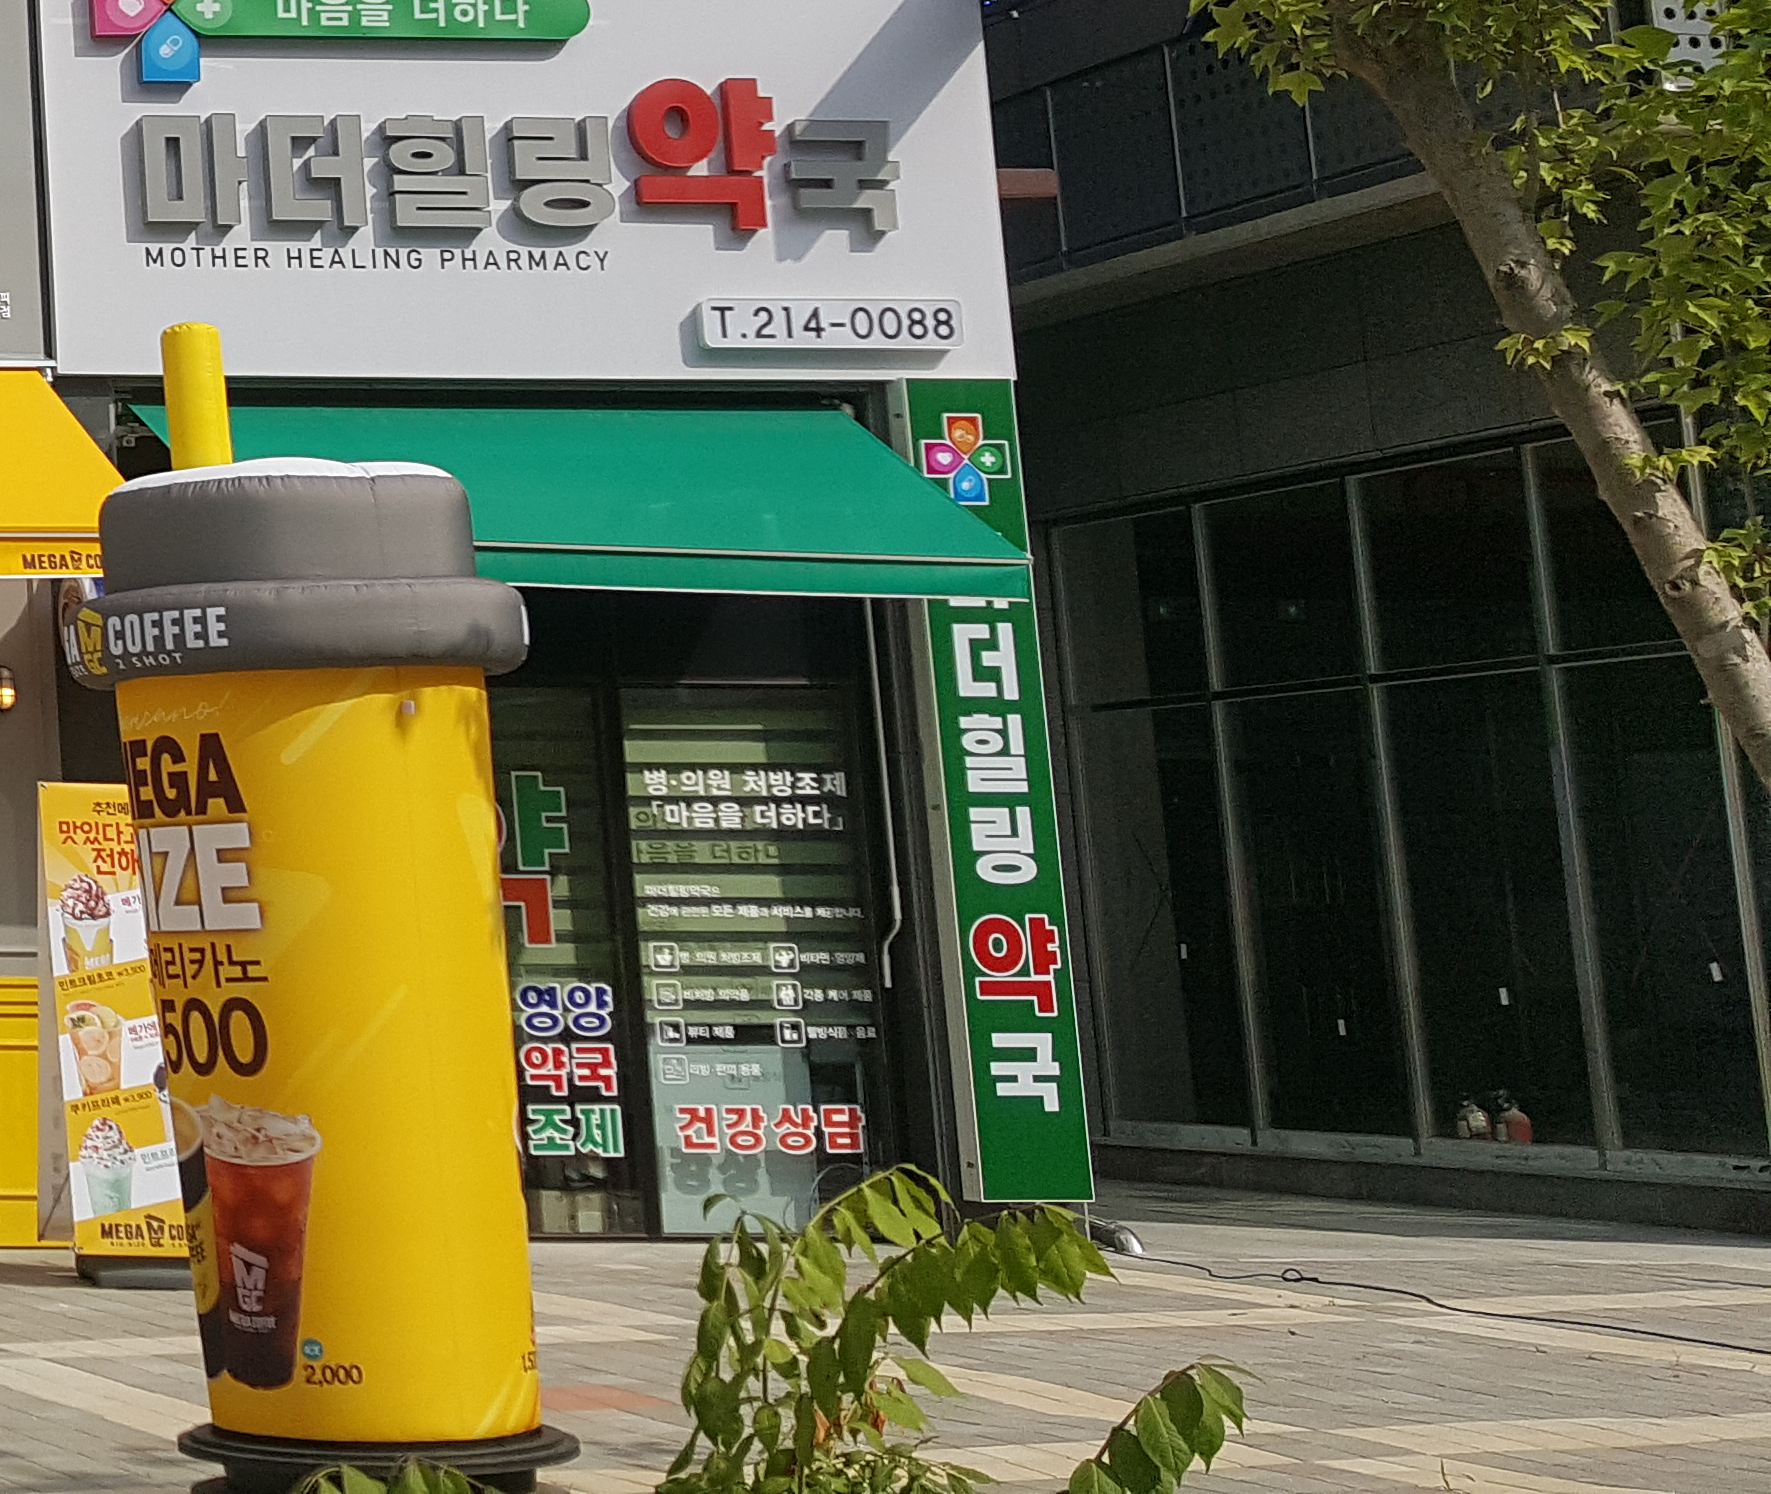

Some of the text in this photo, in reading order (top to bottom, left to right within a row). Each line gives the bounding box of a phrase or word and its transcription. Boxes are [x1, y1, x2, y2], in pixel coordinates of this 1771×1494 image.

[137, 77, 900, 235] 마더힐링약국
[144, 247, 611, 273] MOTHER HEALING PHARMACY
[710, 304, 956, 342] T.214-0088
[22, 554, 69, 569] MEGA
[107, 607, 229, 655] COFFEE
[115, 653, 182, 669] 2 SHOT
[743, 770, 847, 797] 처방조제
[516, 982, 613, 1036] 영양
[520, 1043, 619, 1097] 약국
[525, 1103, 626, 1157] 조제
[676, 1105, 865, 1154] 건강상담
[101, 1223, 144, 1240] MEGA
[303, 1364, 362, 1387] 2,000
